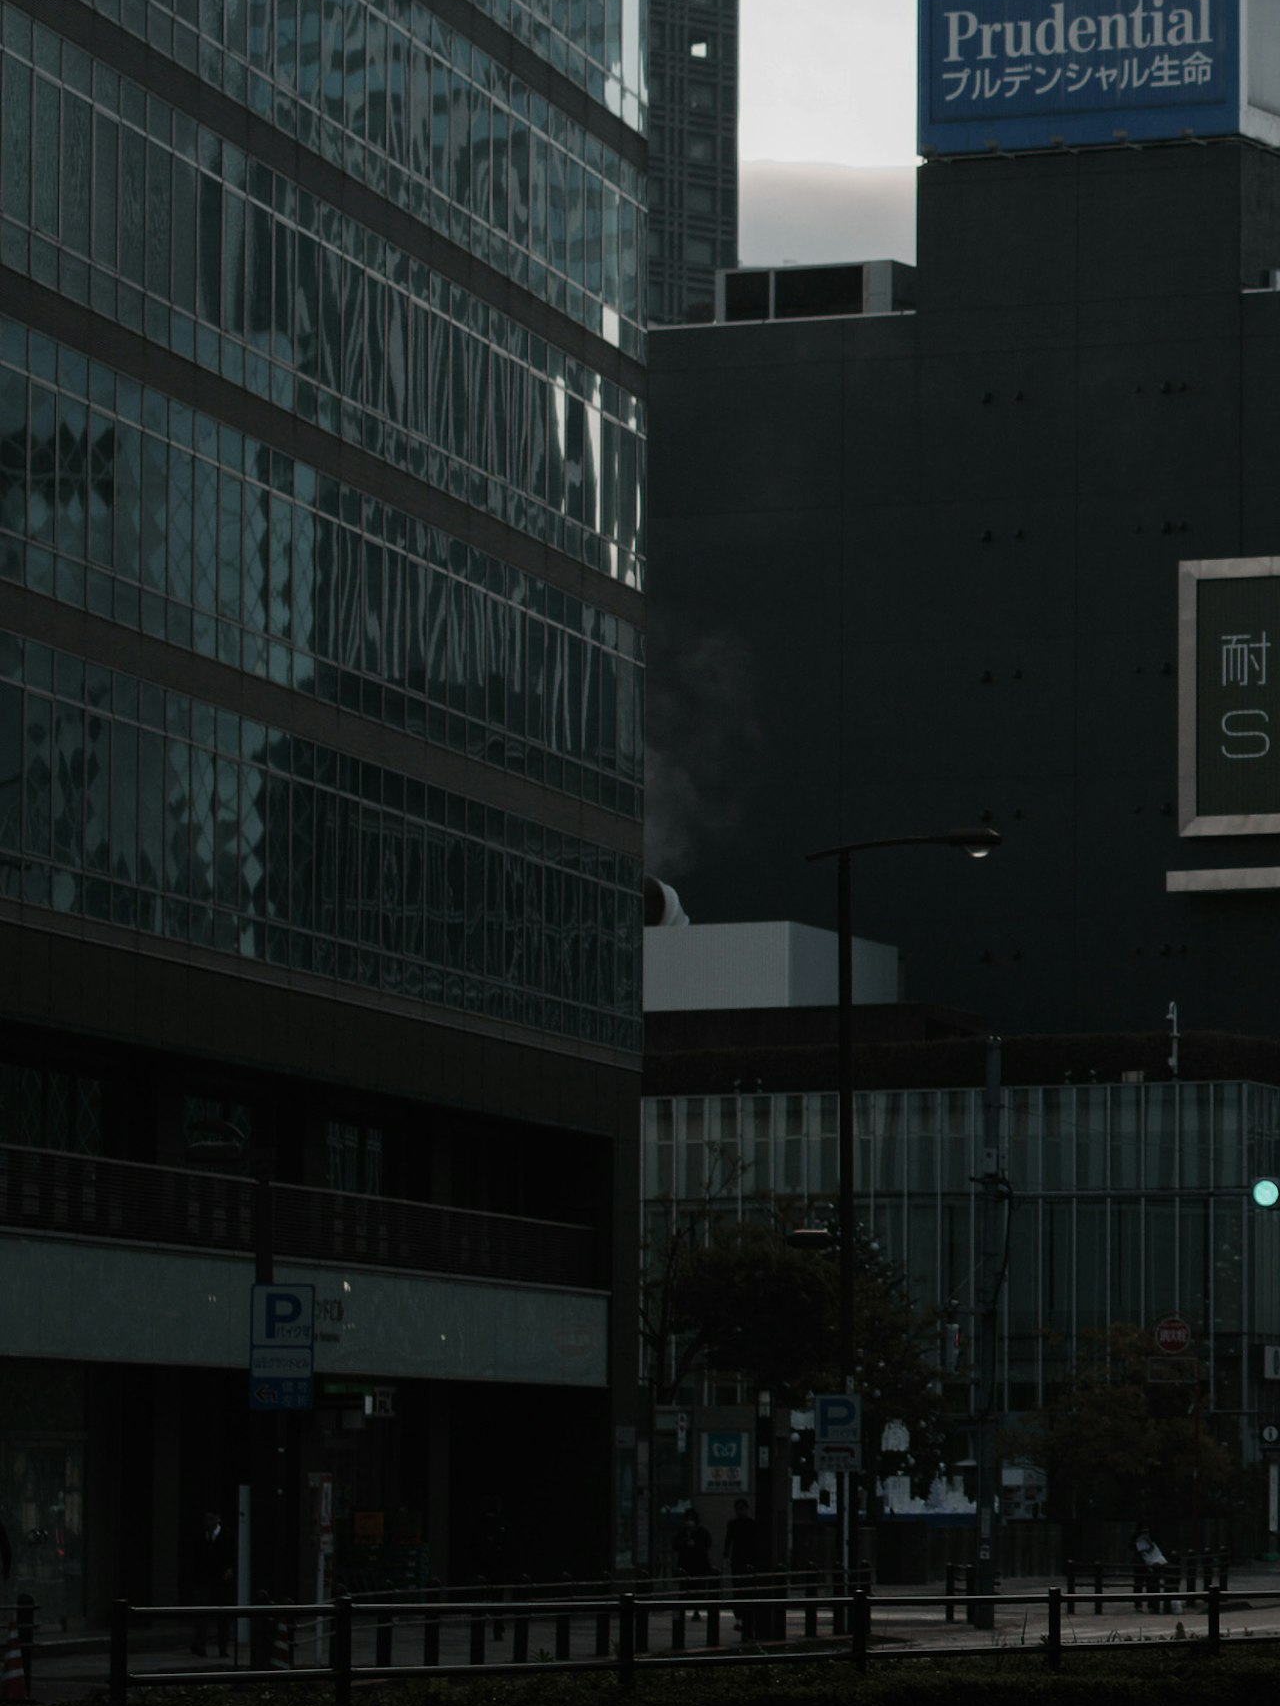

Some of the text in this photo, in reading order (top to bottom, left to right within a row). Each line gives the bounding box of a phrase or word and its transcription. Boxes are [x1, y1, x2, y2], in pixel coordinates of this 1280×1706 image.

[942, 53, 1214, 102] プルデンシャル生命
[265, 1292, 302, 1339] P
[820, 1397, 856, 1438] P
